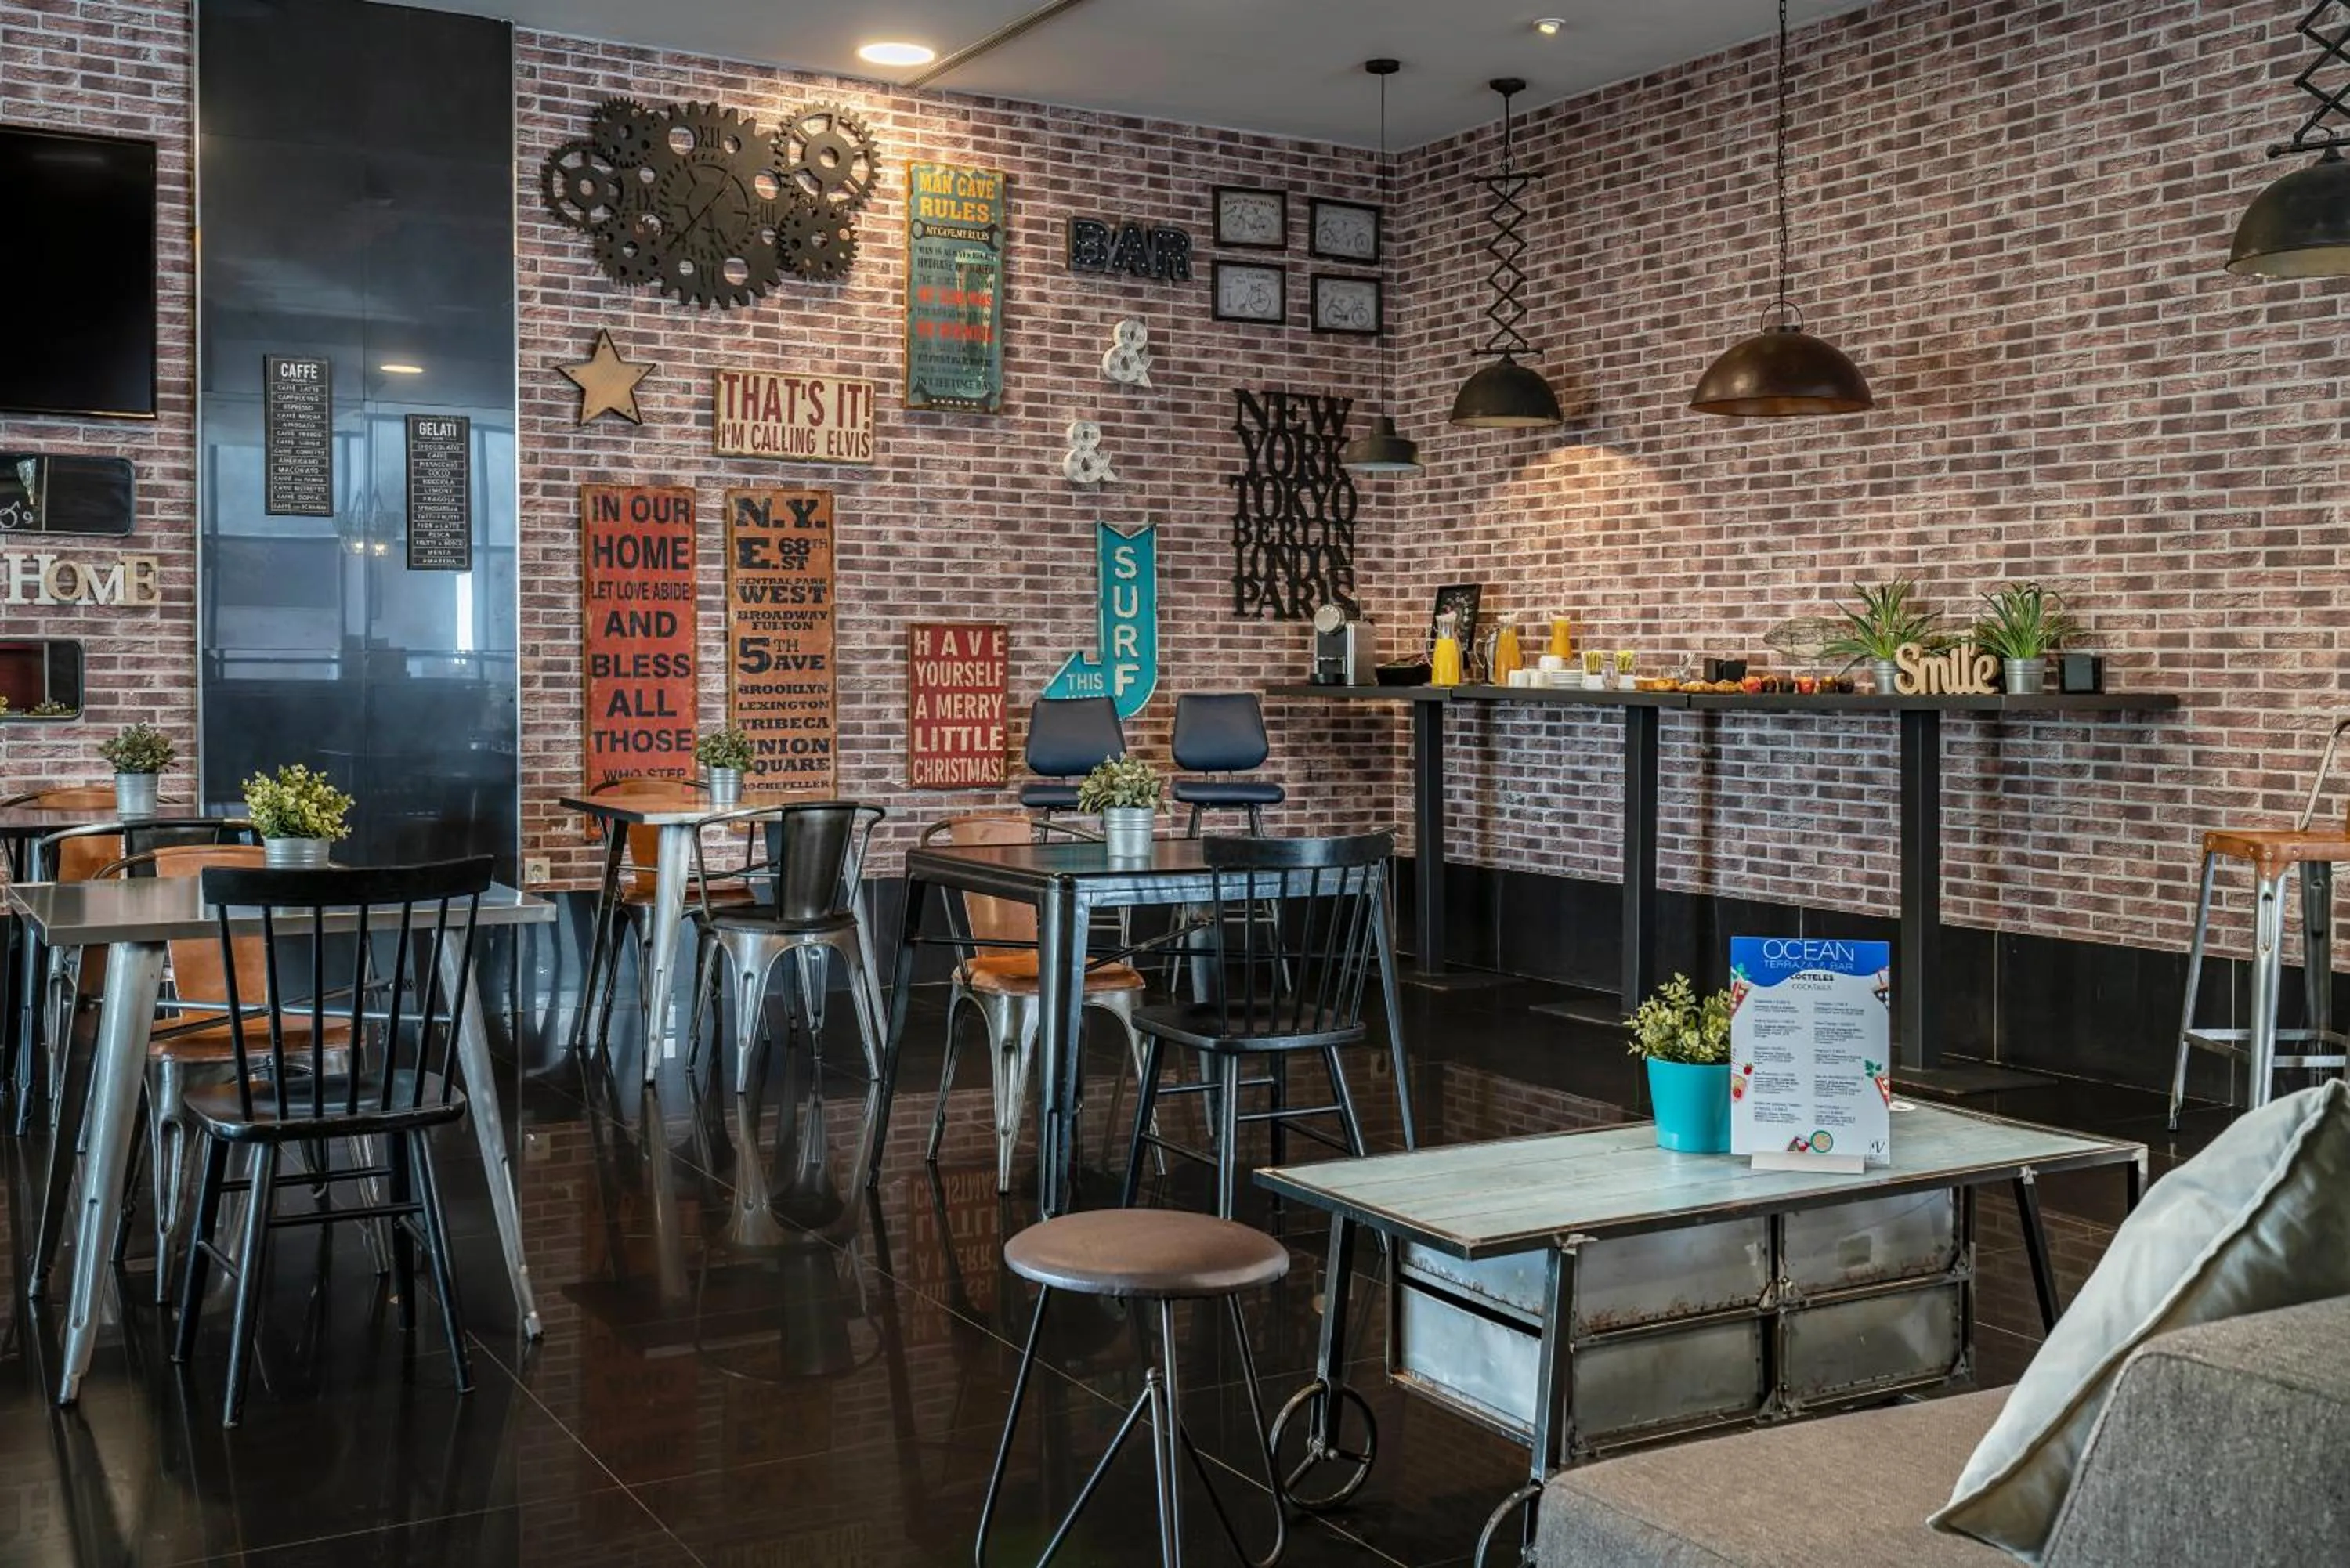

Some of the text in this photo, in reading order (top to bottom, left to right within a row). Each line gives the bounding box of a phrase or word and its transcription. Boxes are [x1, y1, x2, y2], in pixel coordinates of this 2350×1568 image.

[920, 172, 996, 200] MAN CAVE
[1070, 217, 1191, 282] BAR
[1102, 320, 1152, 388] &
[724, 373, 872, 430] THAT'S IT!
[1233, 388, 1354, 435] NEW
[419, 422, 457, 438] GELATI
[721, 422, 870, 458] I'M CALLING ELVIS
[1063, 420, 1117, 484] &
[1232, 426, 1352, 484] YORK
[592, 495, 691, 525] IN OUR
[1230, 474, 1358, 524] TOKYO
[1232, 513, 1354, 551] BERLIN
[592, 534, 691, 571] HOME
[736, 537, 779, 569] E.
[782, 555, 809, 570] ST
[3, 553, 162, 606] HOME
[591, 582, 613, 600] LET
[616, 582, 649, 601] LOVE
[737, 585, 828, 604] WEST
[604, 611, 678, 639] AND
[737, 610, 828, 620] BROADWAY
[752, 621, 814, 630] FULTON
[1113, 546, 1141, 696] SURF
[913, 630, 1006, 657] HAVE
[591, 653, 692, 679] BLESS
[773, 655, 826, 671] AVE
[913, 661, 1004, 688] YOURSELF
[1894, 629, 1998, 695] Smile
[738, 683, 829, 694] BROOKLYN
[1066, 672, 1104, 691] THIS
[606, 689, 678, 718] ALL
[738, 701, 830, 711] LEXINGTON
[915, 693, 1003, 720] A MERRY
[738, 717, 830, 730] TRIBECA
[593, 728, 693, 754] THOSE
[747, 739, 830, 755] NION
[915, 726, 1004, 753] LITTLE
[754, 757, 830, 775] QUARE
[913, 757, 1004, 782] CHRISTMAS!
[1763, 940, 1854, 962] OCEAN
[1763, 959, 1814, 970] TERRAZA
[1790, 974, 1834, 982] COCTELES
